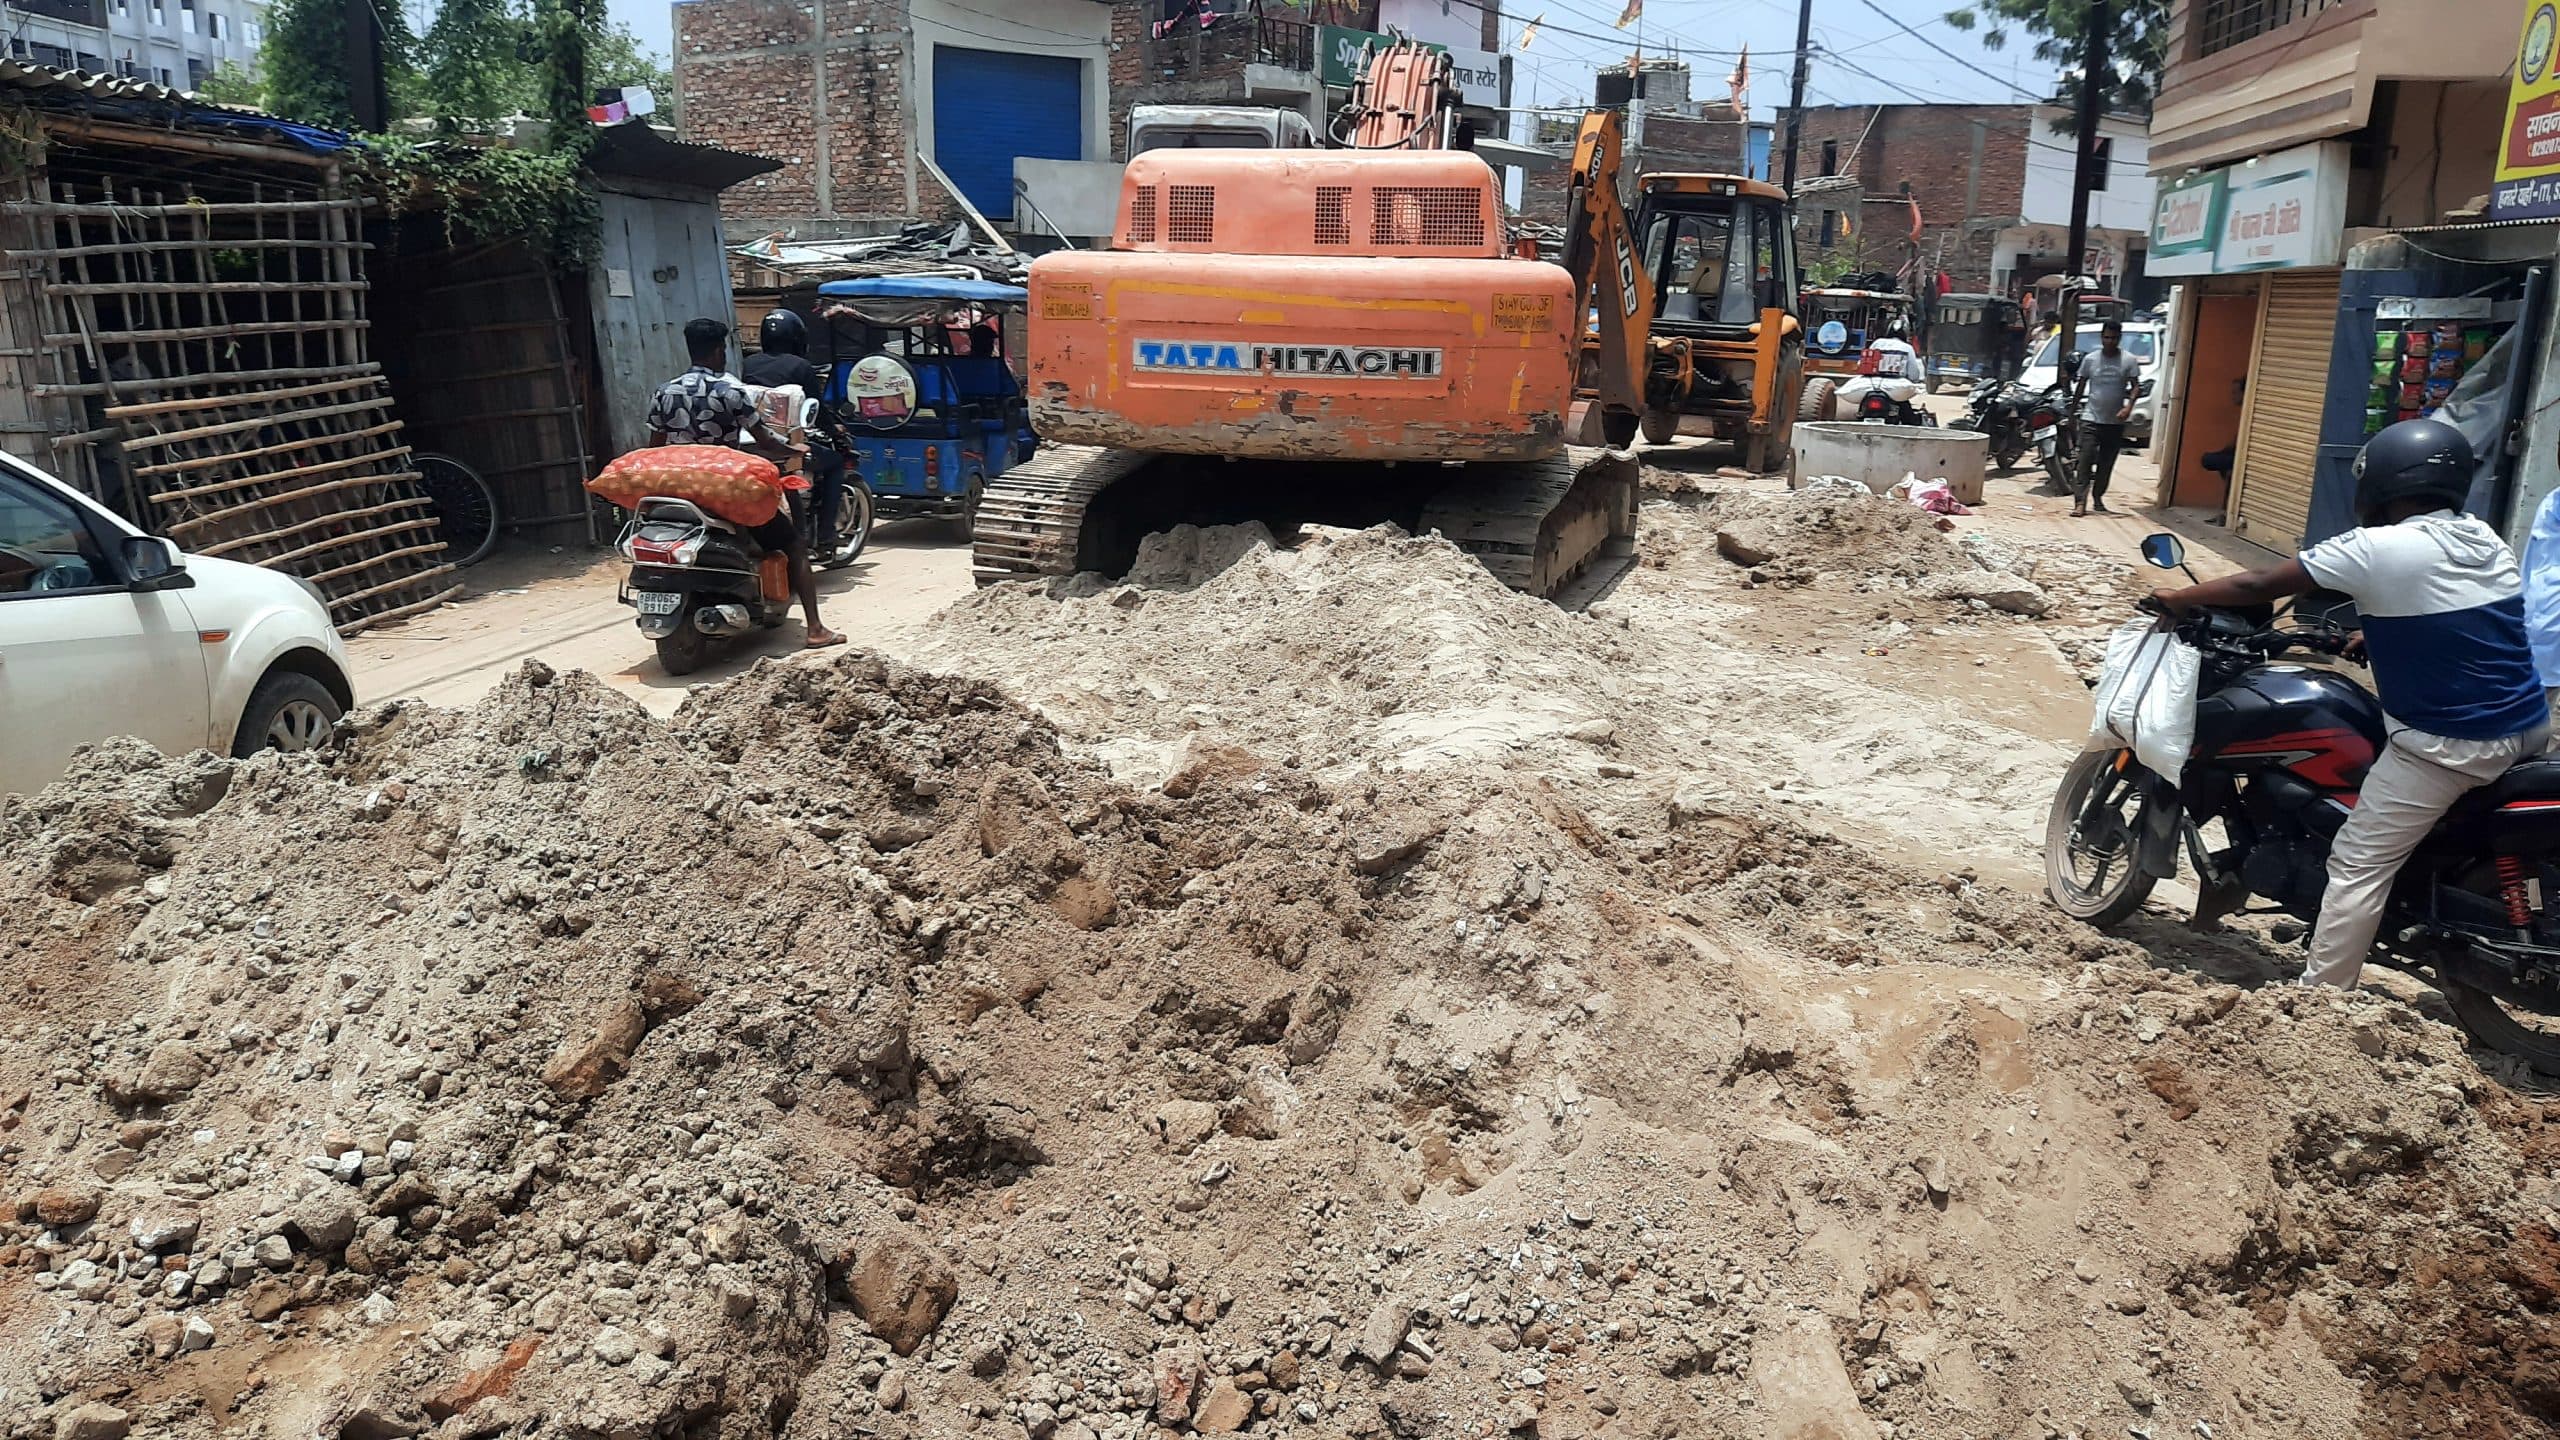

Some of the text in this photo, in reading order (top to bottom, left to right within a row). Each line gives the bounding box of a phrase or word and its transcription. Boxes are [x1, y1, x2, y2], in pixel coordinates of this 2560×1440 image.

[1475, 65, 1497, 88] स्टोर
[1616, 237, 1638, 319] JCB
[1140, 342, 1436, 376] TATA HITACHI
